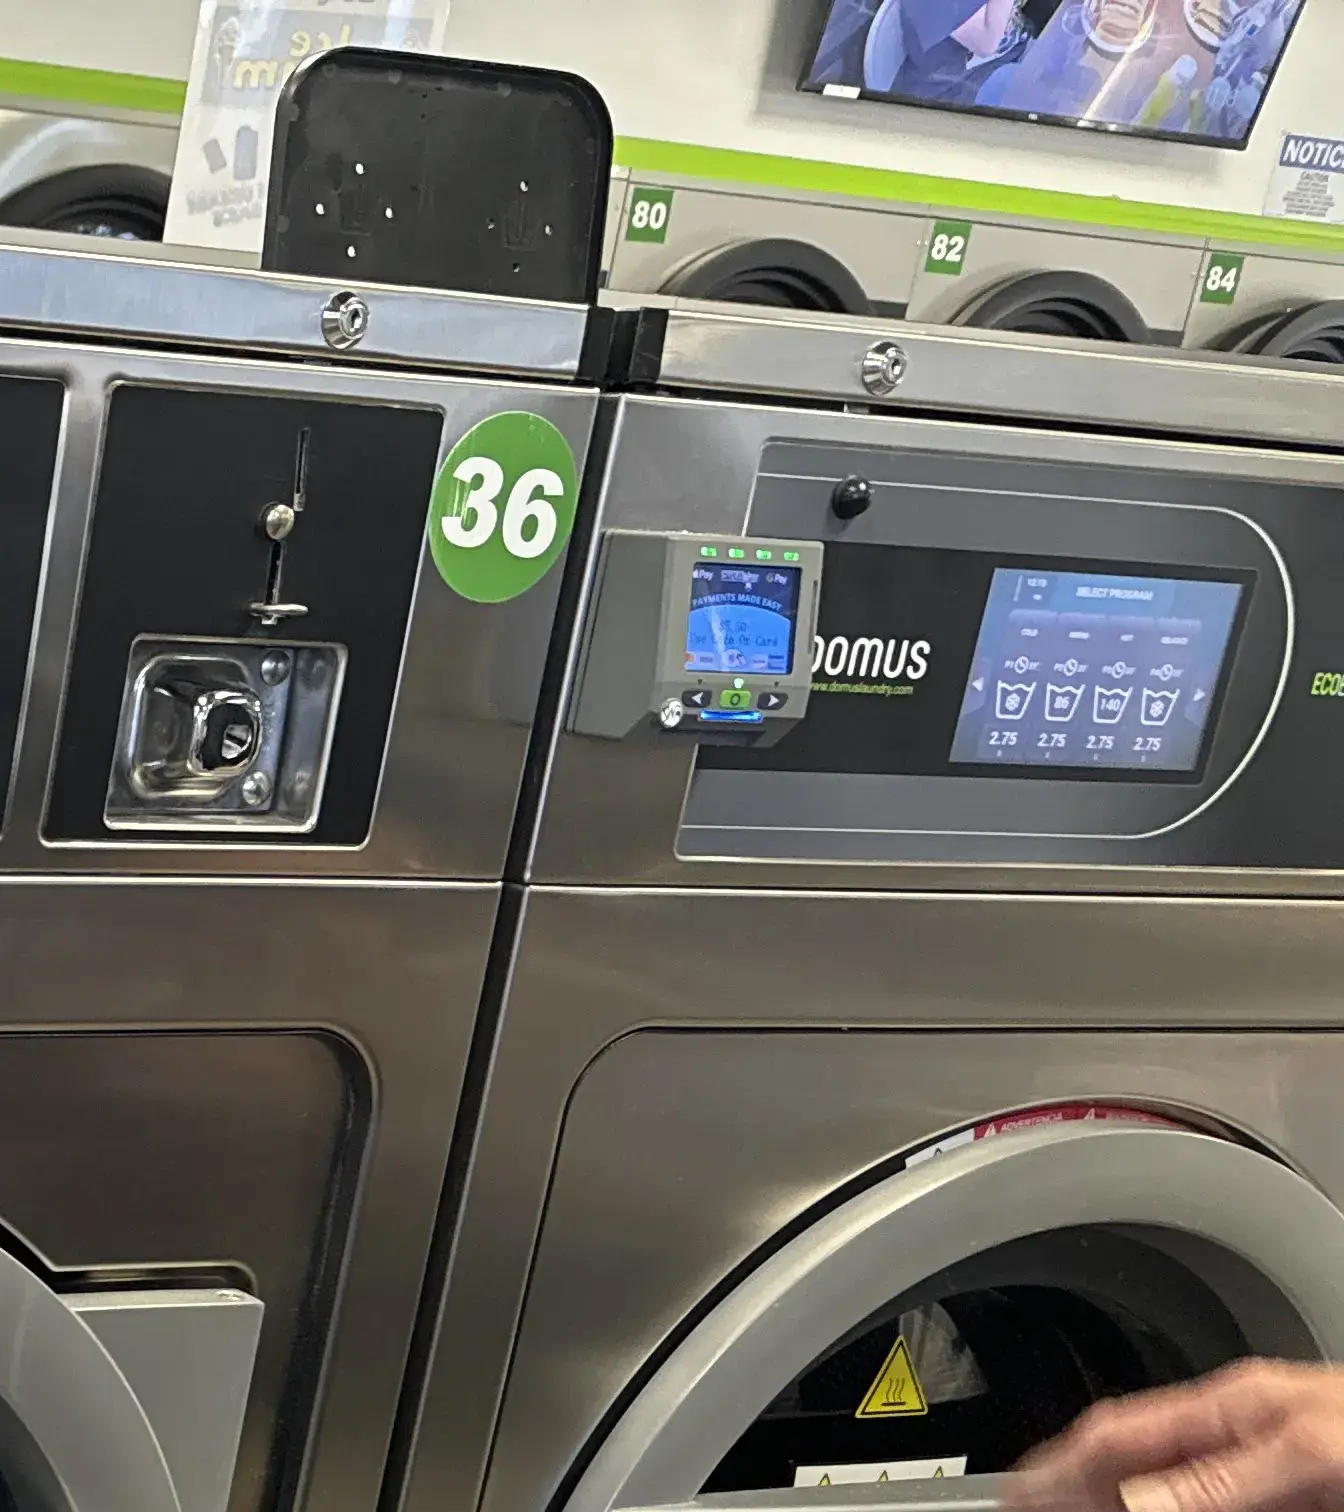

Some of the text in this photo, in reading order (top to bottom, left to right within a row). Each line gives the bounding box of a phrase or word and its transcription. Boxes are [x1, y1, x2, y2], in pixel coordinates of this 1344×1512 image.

[1283, 139, 1344, 168] NOTIC
[632, 200, 666, 230] 80
[931, 233, 964, 262] 82
[1206, 265, 1237, 292] 84
[441, 456, 564, 558] 36
[693, 593, 736, 607] PAYMENTS
[1311, 672, 1344, 696] ECO
[1100, 698, 1121, 711] 140
[989, 731, 1018, 746] 2.75
[1037, 733, 1067, 747] 2.75
[1086, 735, 1115, 749] 2.75
[1133, 737, 1161, 751] 2.75
